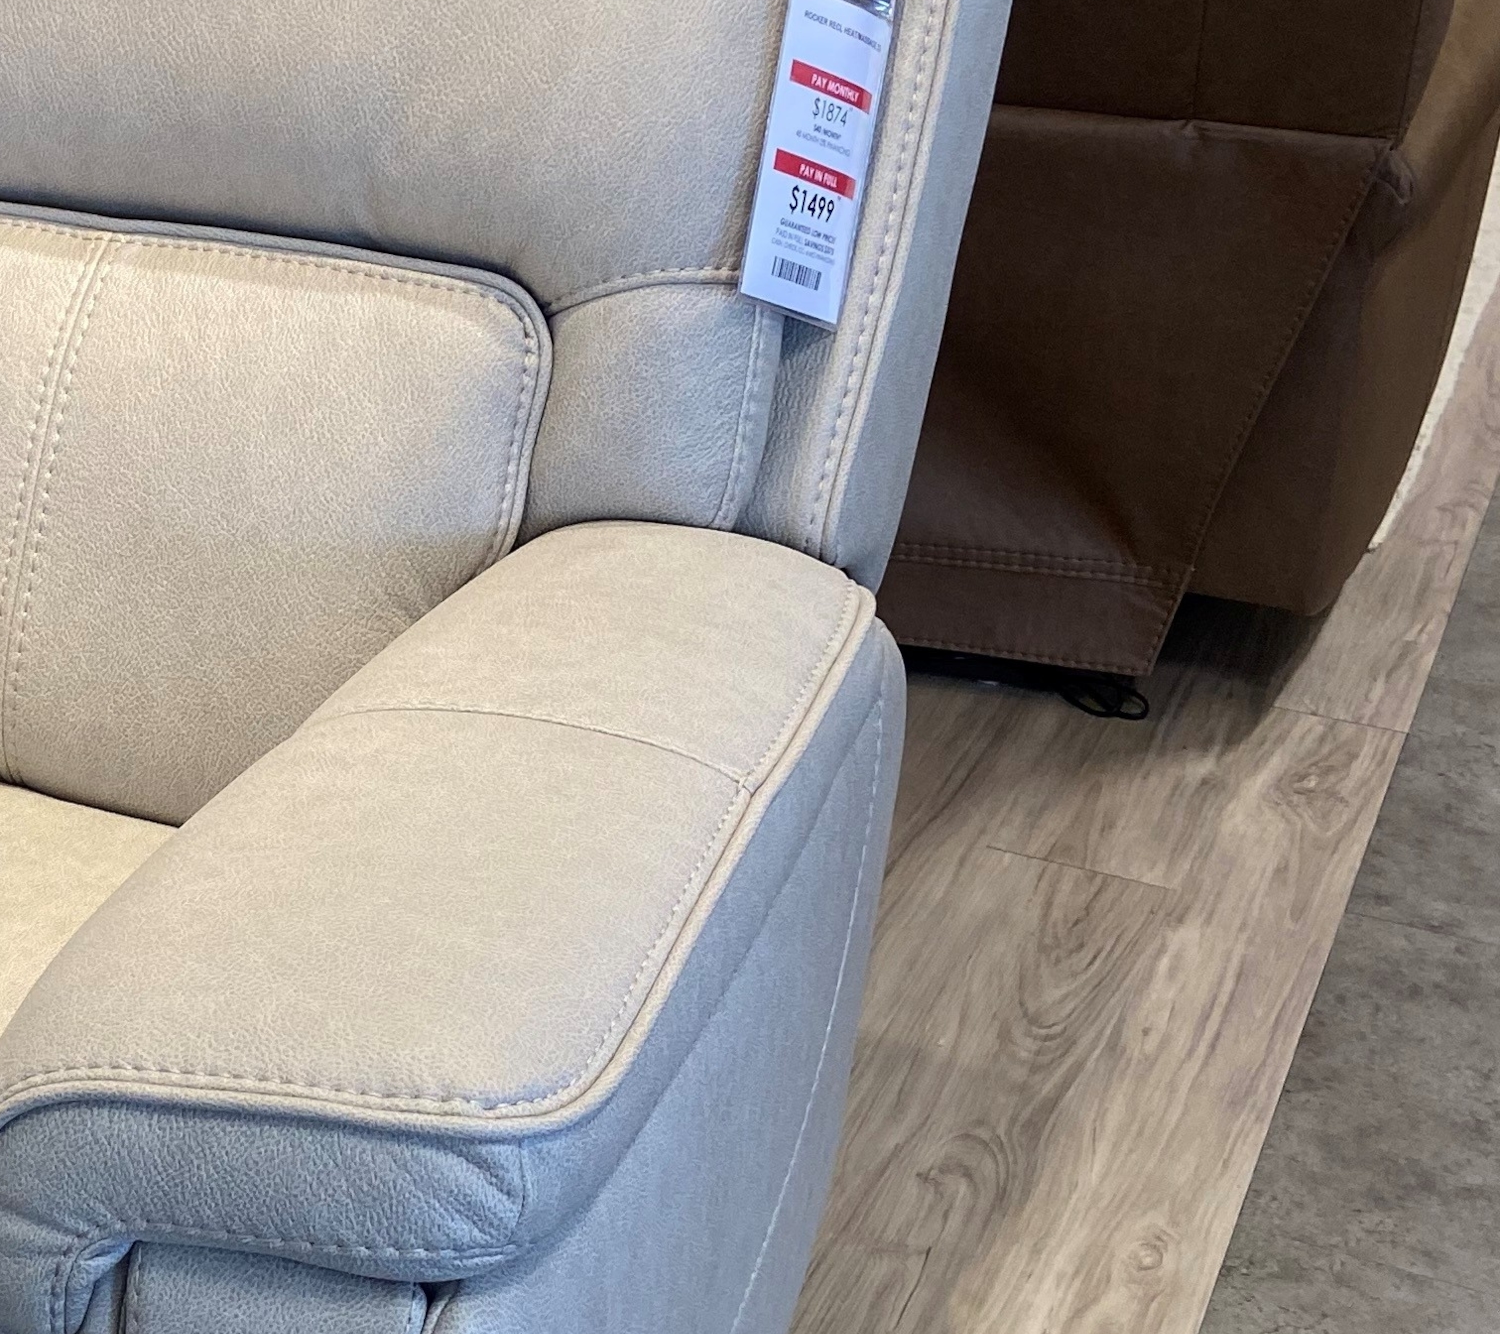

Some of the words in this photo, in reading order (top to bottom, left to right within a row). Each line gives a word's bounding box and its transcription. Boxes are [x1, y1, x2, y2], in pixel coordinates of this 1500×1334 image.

[811, 73, 827, 91] PAY
[828, 81, 860, 103] MONTHLY
[812, 97, 849, 127] $1874
[799, 163, 815, 178] PAY
[815, 170, 824, 182] IN
[823, 174, 838, 188] FULL
[789, 185, 835, 223] $1499
